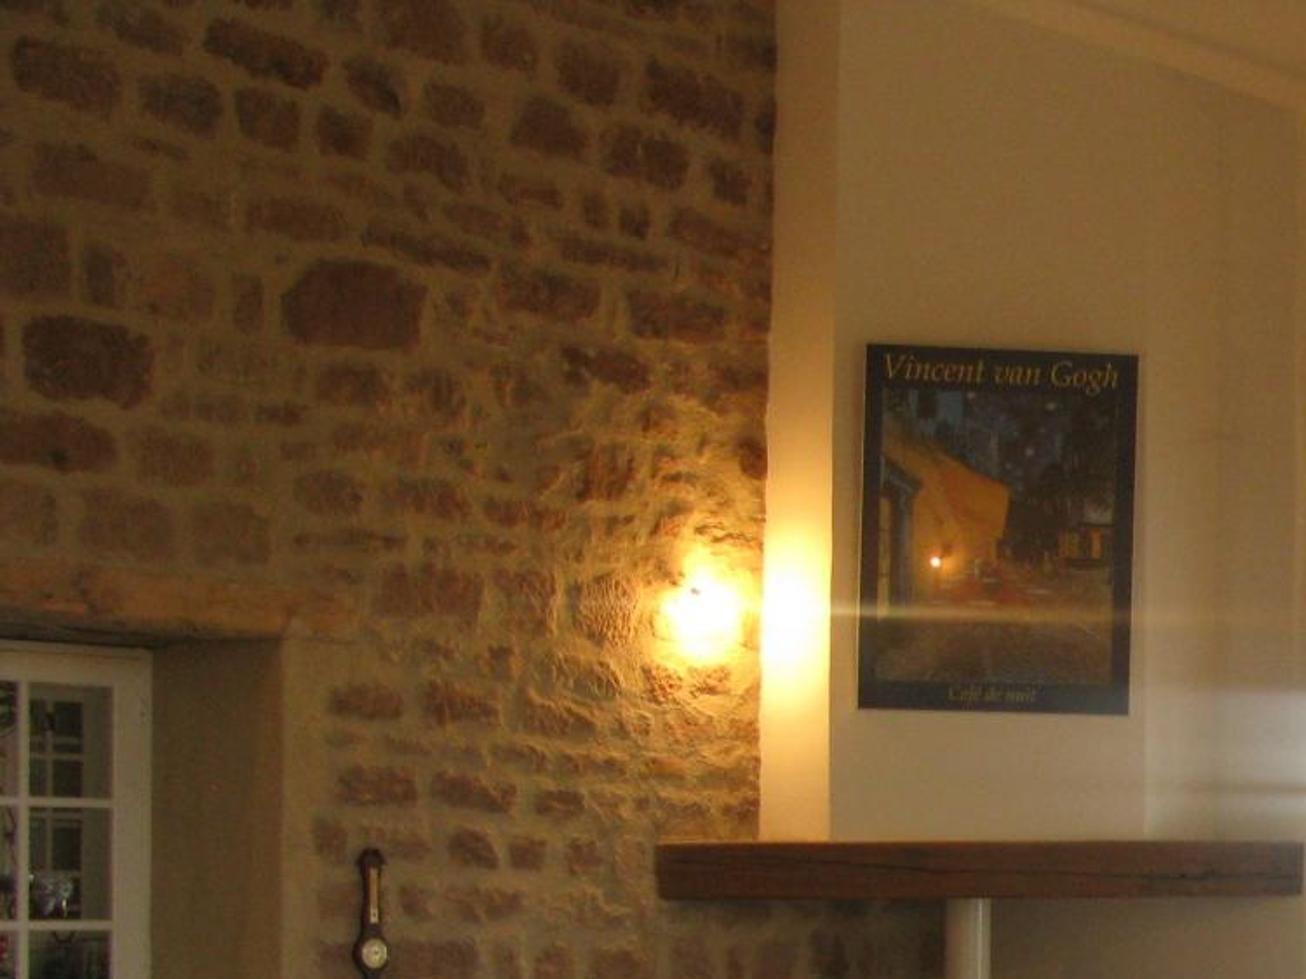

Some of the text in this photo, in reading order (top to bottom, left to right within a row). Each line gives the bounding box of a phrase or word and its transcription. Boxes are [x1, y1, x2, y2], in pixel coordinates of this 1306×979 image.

[884, 352, 1120, 395] Vincent van Gogh
